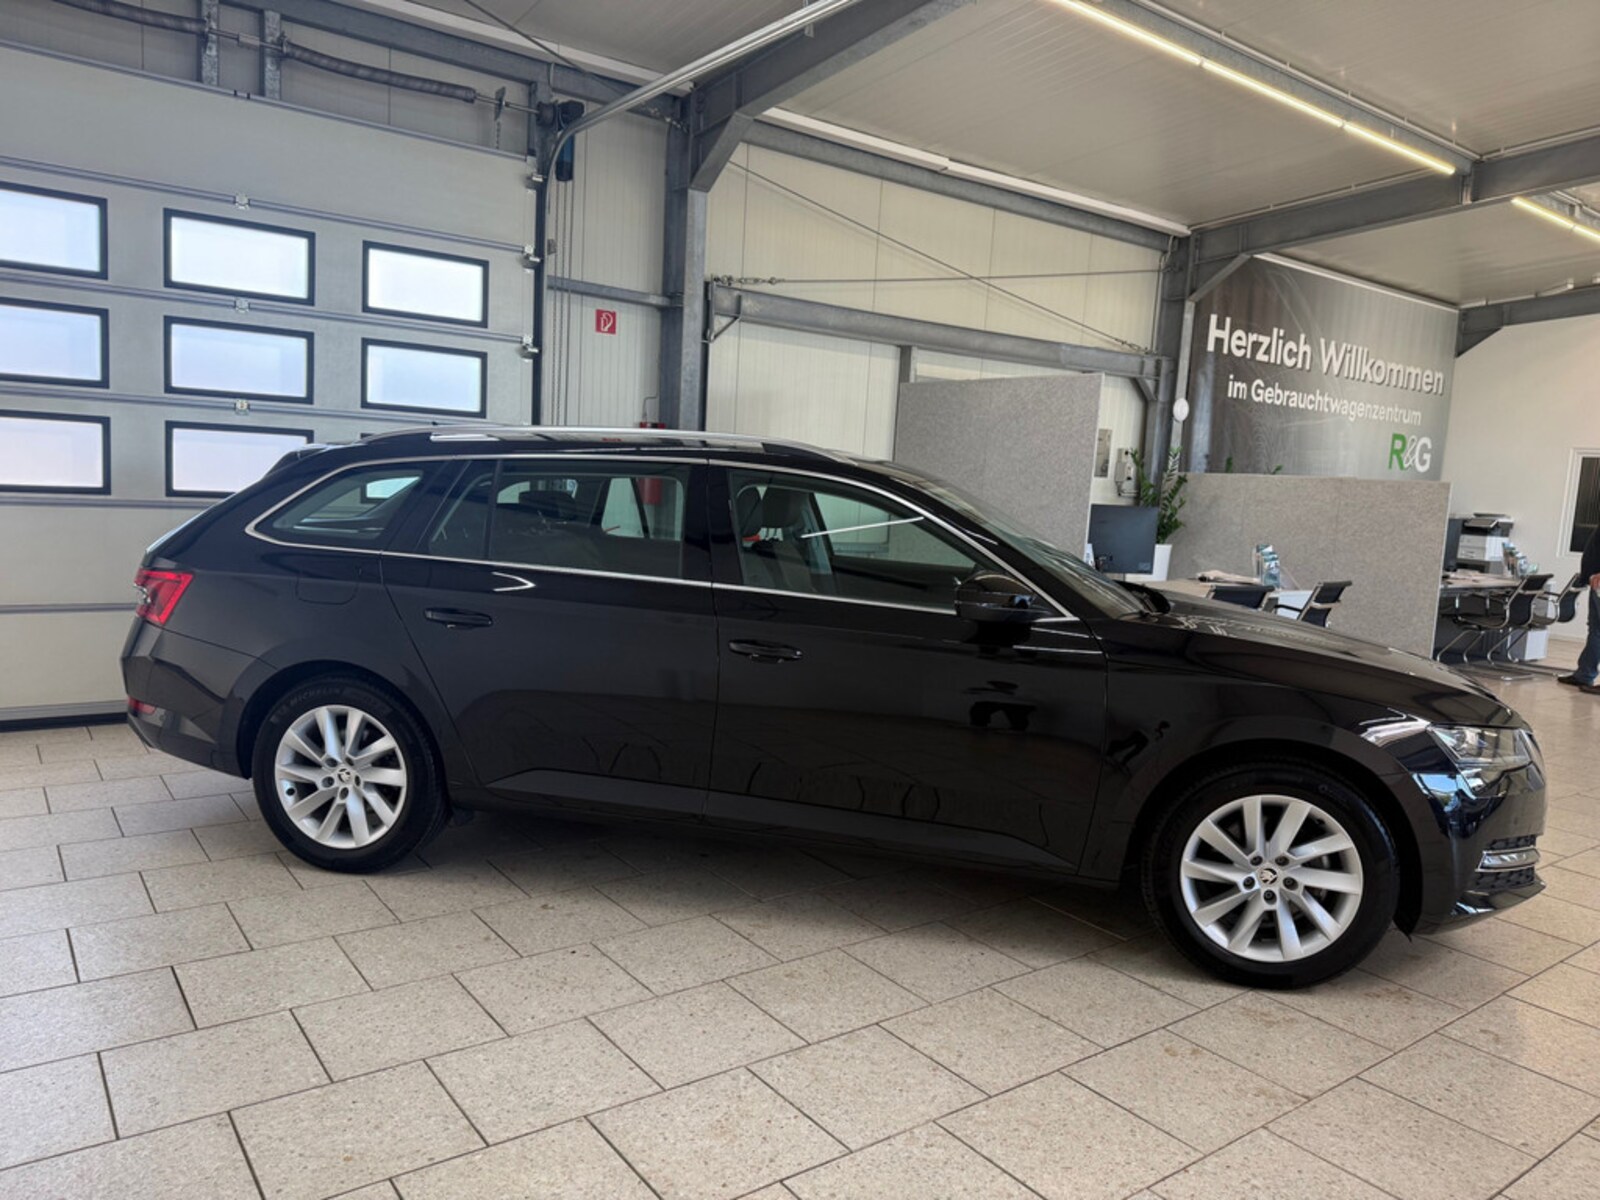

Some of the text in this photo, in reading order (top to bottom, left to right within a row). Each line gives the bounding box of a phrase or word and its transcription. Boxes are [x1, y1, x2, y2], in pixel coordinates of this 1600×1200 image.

[1207, 313, 1444, 395] Herzlich Willkommen
[1227, 375, 1422, 426] im Gebrauchtwagenzentrum
